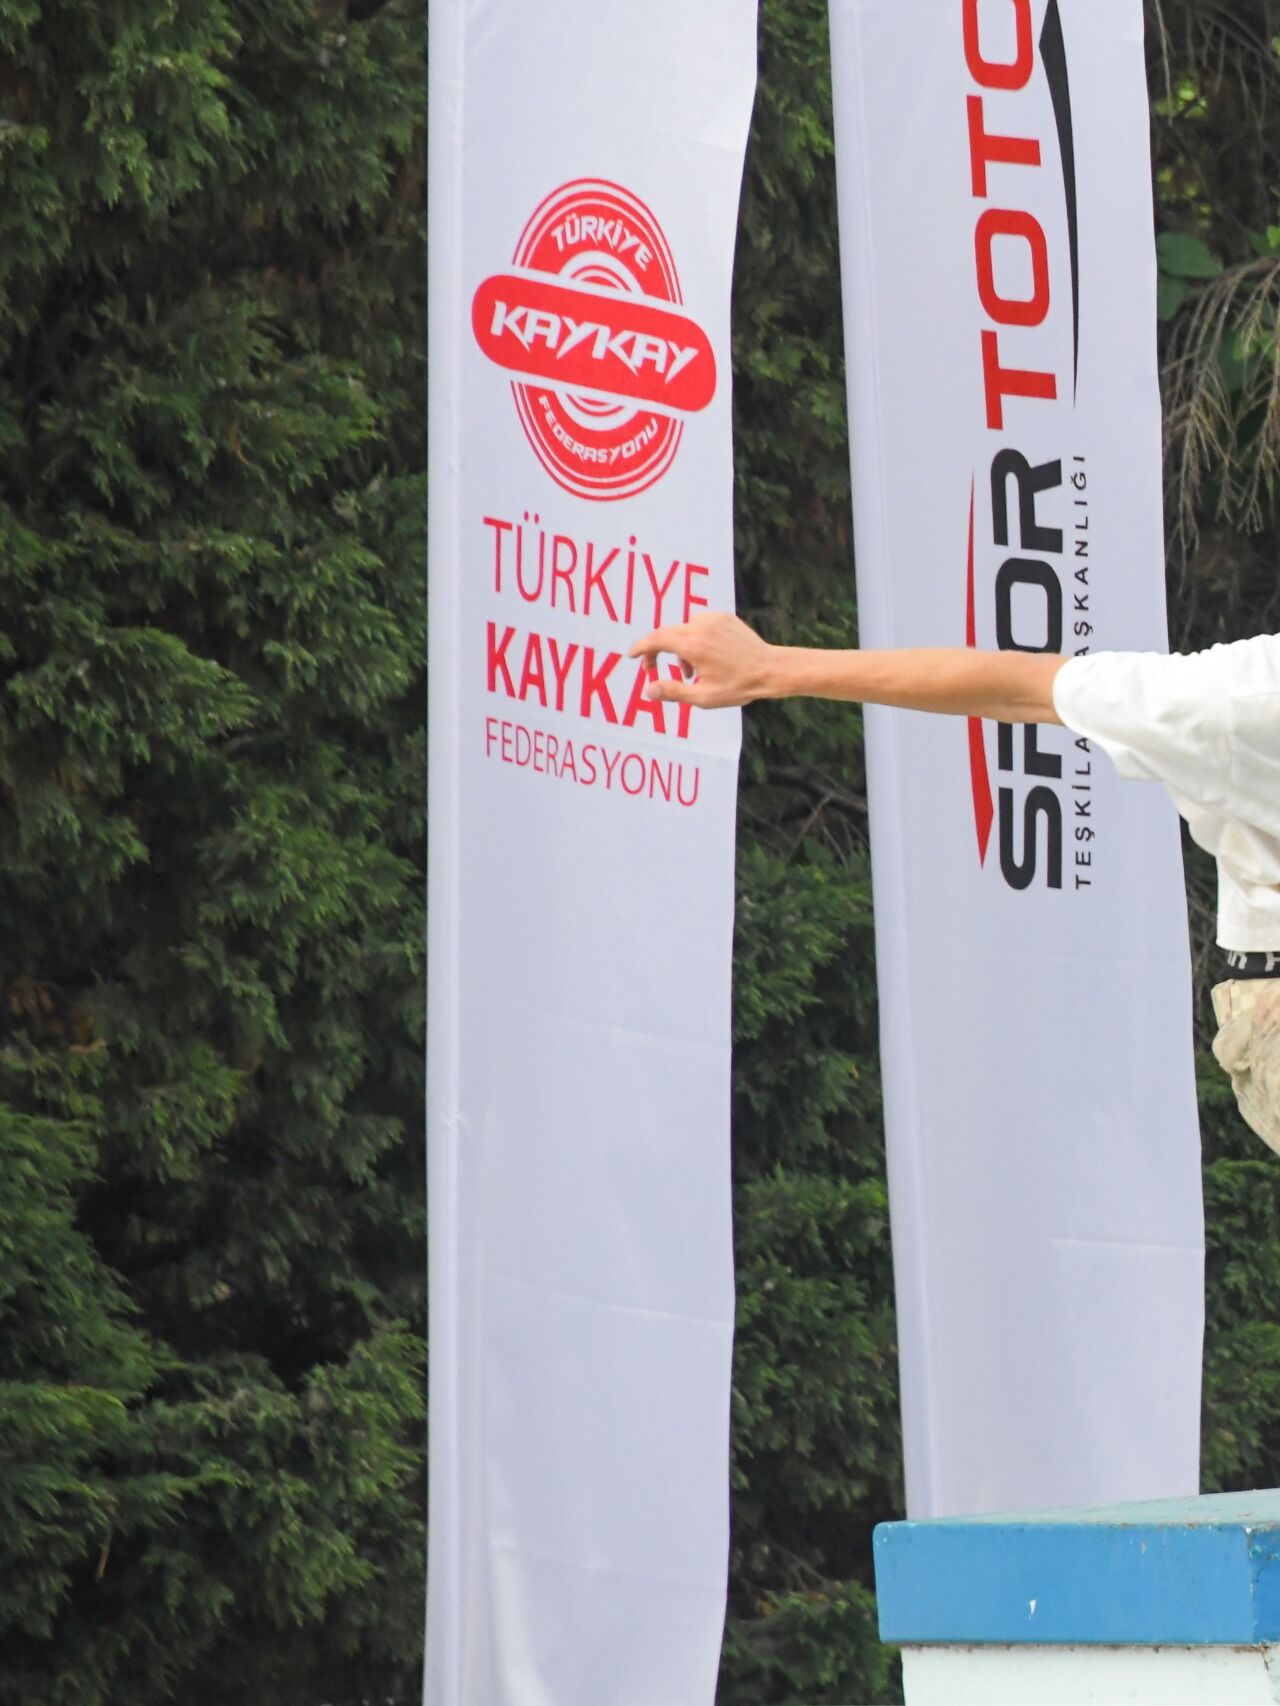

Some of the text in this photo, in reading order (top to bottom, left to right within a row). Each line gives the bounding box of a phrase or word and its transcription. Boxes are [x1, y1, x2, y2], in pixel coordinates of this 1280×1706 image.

[551, 213, 653, 272] TÜRKİYE
[490, 300, 699, 384] KAYKAY
[538, 395, 659, 465] FEDERASYONU
[1072, 455, 1096, 889] TEŞKİLA AŞKANLIĞI
[485, 716, 700, 807] FEDERASYONU
